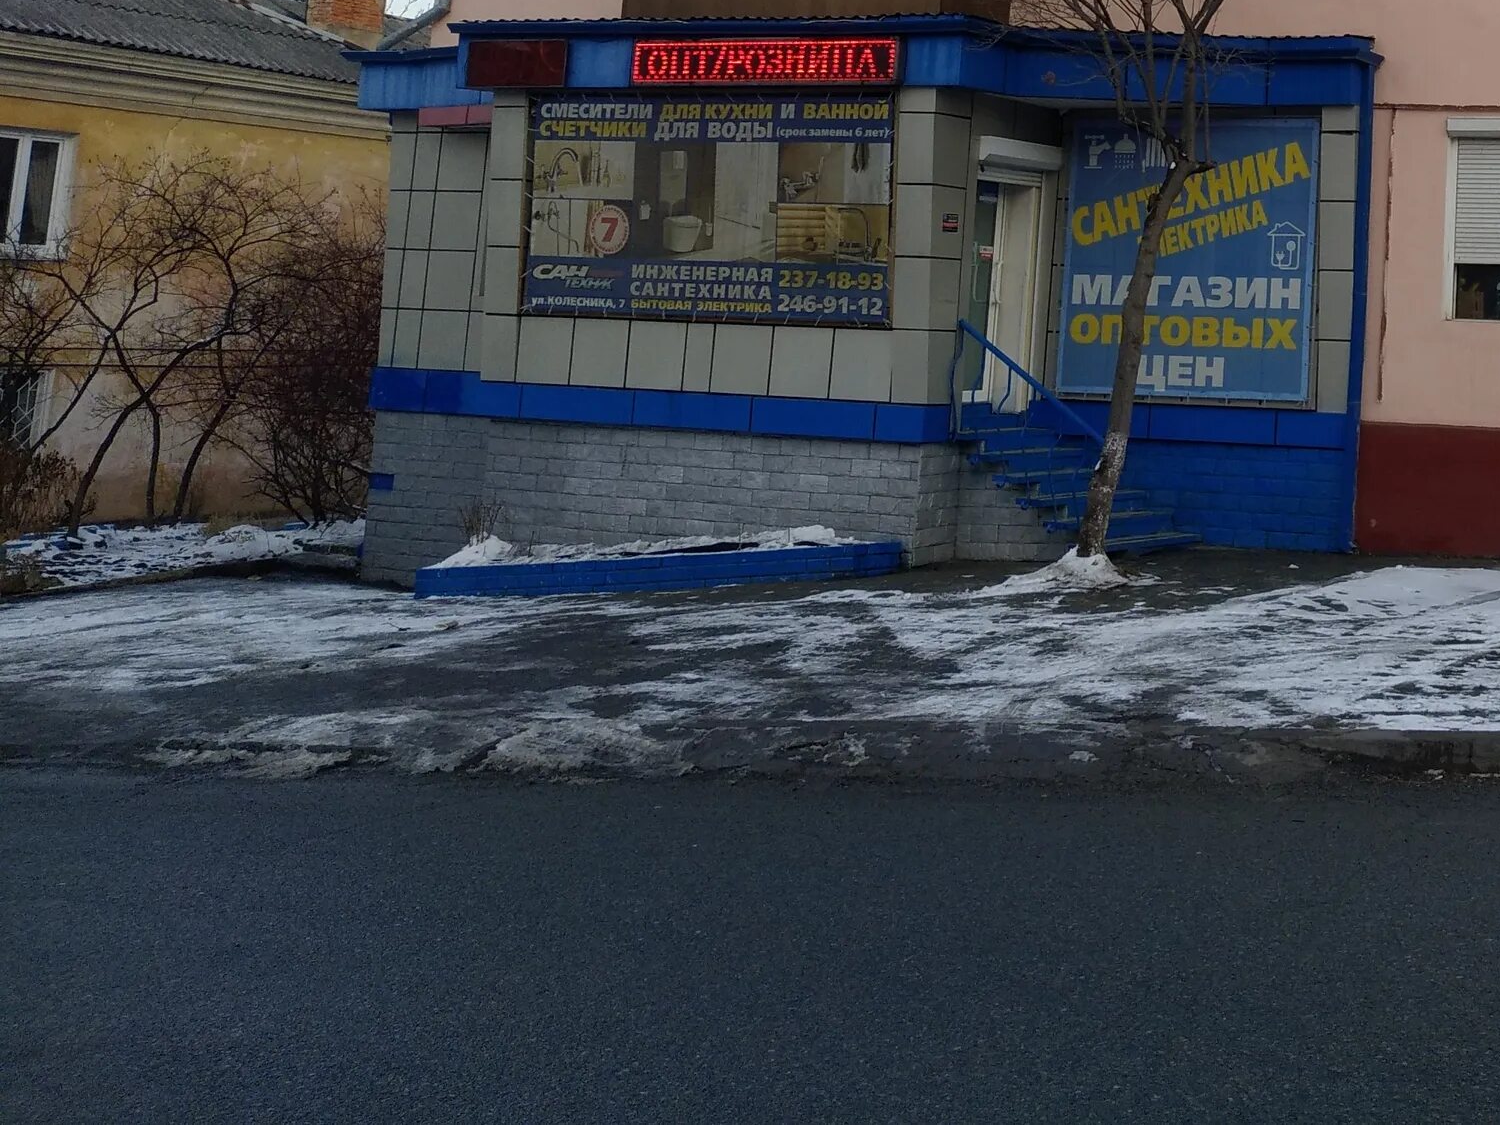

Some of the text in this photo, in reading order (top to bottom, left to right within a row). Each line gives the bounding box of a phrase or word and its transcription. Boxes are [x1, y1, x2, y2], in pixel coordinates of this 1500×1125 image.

[541, 100, 889, 122] СМЕСИТЕЛИ ДЛЯ КУХНИ И ВАННОЙ
[539, 121, 888, 142] СЧЕТЧИКИ ДЛЯ ВОДЫ (срок замены 6 лет)
[600, 217, 619, 242] 7
[1137, 200, 1269, 258] ЕКТРИКА
[532, 264, 590, 280] САН
[631, 264, 773, 282] ИНЖЕНЕРНАЯ
[778, 269, 884, 291] 237-18-93
[564, 278, 616, 290] ТЕХНИК
[630, 282, 772, 300] САНТЕХНИКА
[619, 299, 626, 309] 7
[631, 299, 772, 313] БЫТОВАЯ ЭЛЕКТРИКА
[777, 294, 883, 316] 246-91-12
[1069, 313, 1297, 350] ОПТОВЫХ
[1135, 354, 1225, 392] ЦЕН
